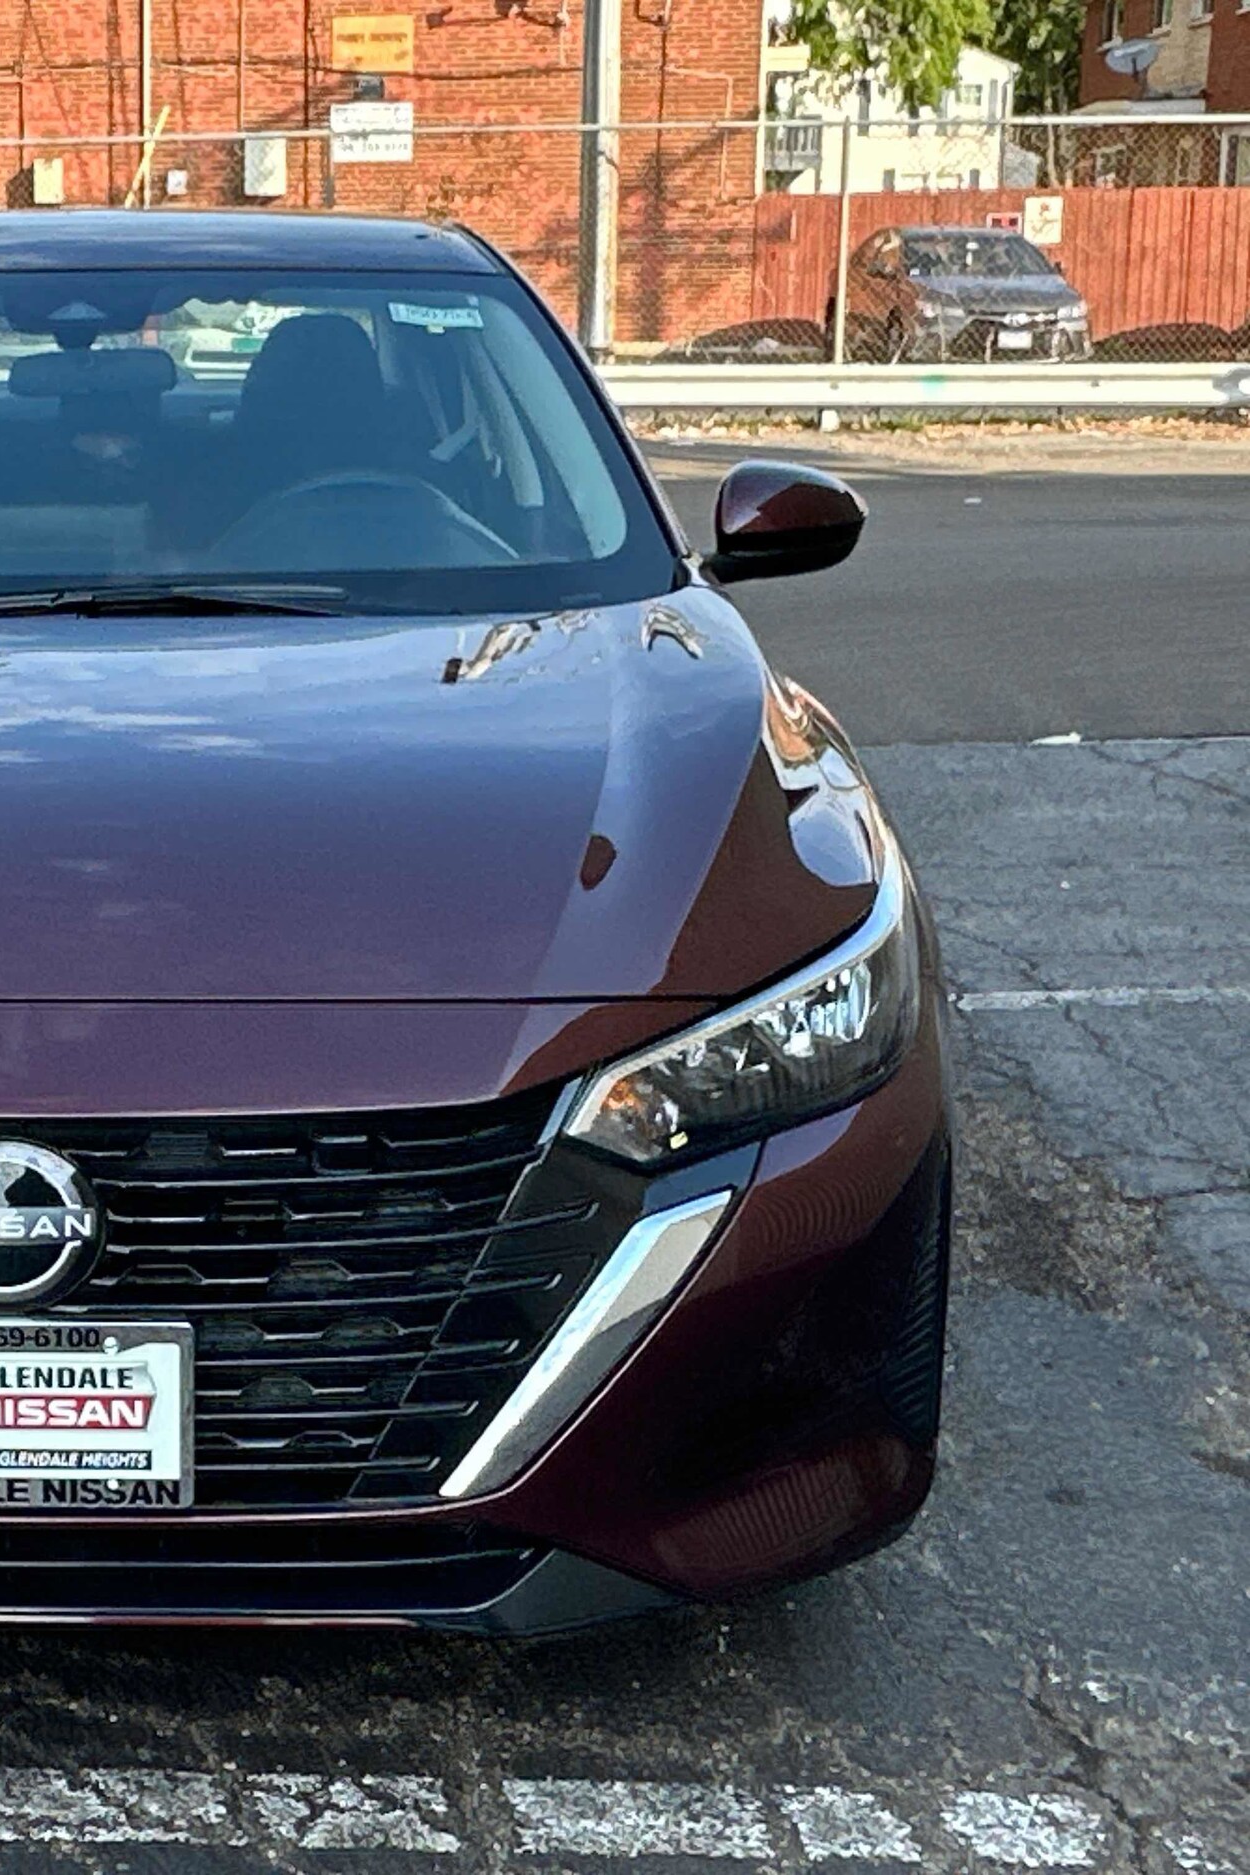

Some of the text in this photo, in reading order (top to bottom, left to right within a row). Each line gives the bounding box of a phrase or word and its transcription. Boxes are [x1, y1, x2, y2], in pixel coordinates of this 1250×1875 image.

[0, 1451, 78, 1468] GLENDALE
[81, 1452, 148, 1469] HEIGHTS
[42, 1478, 181, 1506] NISSAN
